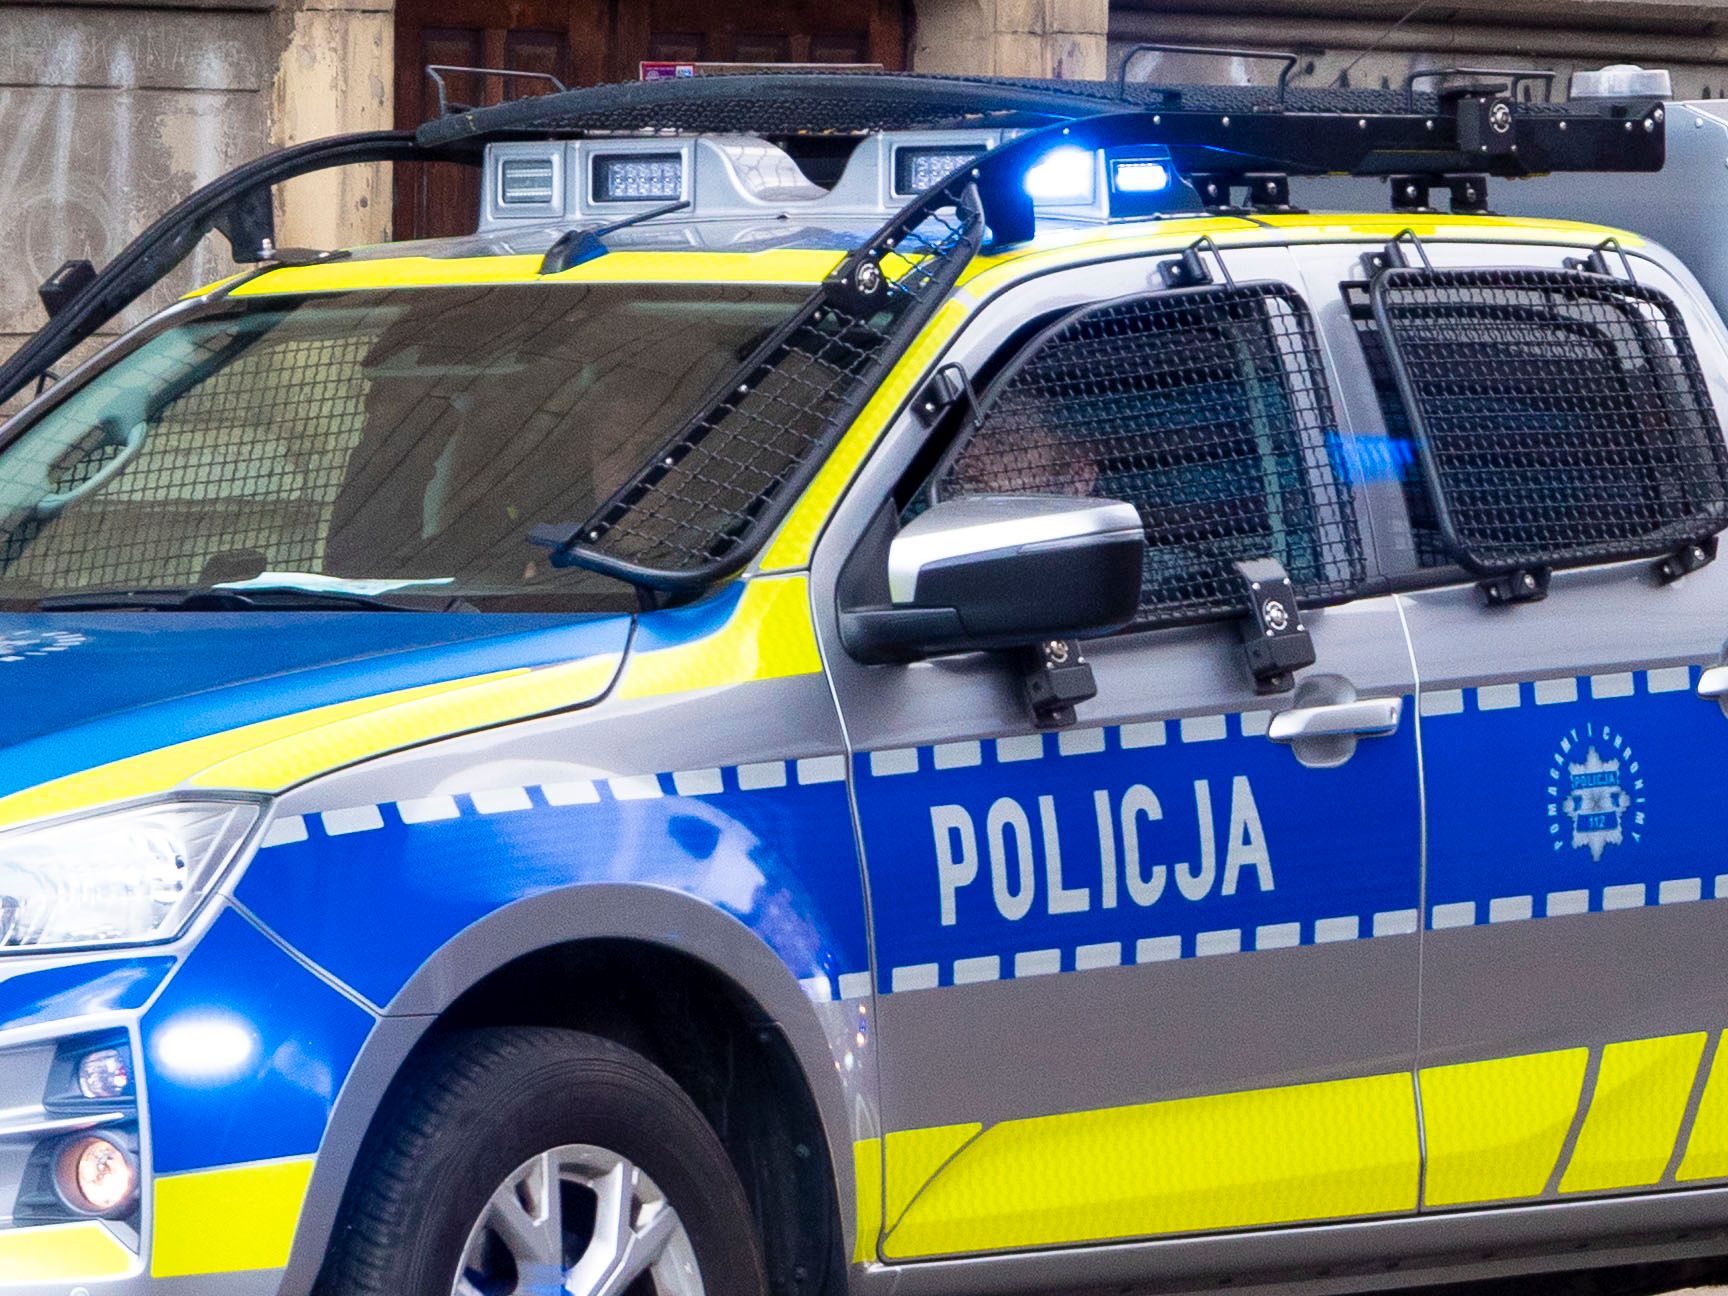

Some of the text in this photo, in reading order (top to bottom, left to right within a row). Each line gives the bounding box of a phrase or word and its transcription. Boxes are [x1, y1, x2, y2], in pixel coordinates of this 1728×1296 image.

[1547, 728, 1579, 851] POMAGAMY
[1602, 725, 1646, 843] CHRONIMY
[1574, 773, 1616, 787] POLICJA
[930, 775, 1275, 926] POLICJA
[1589, 815, 1606, 829] 112
